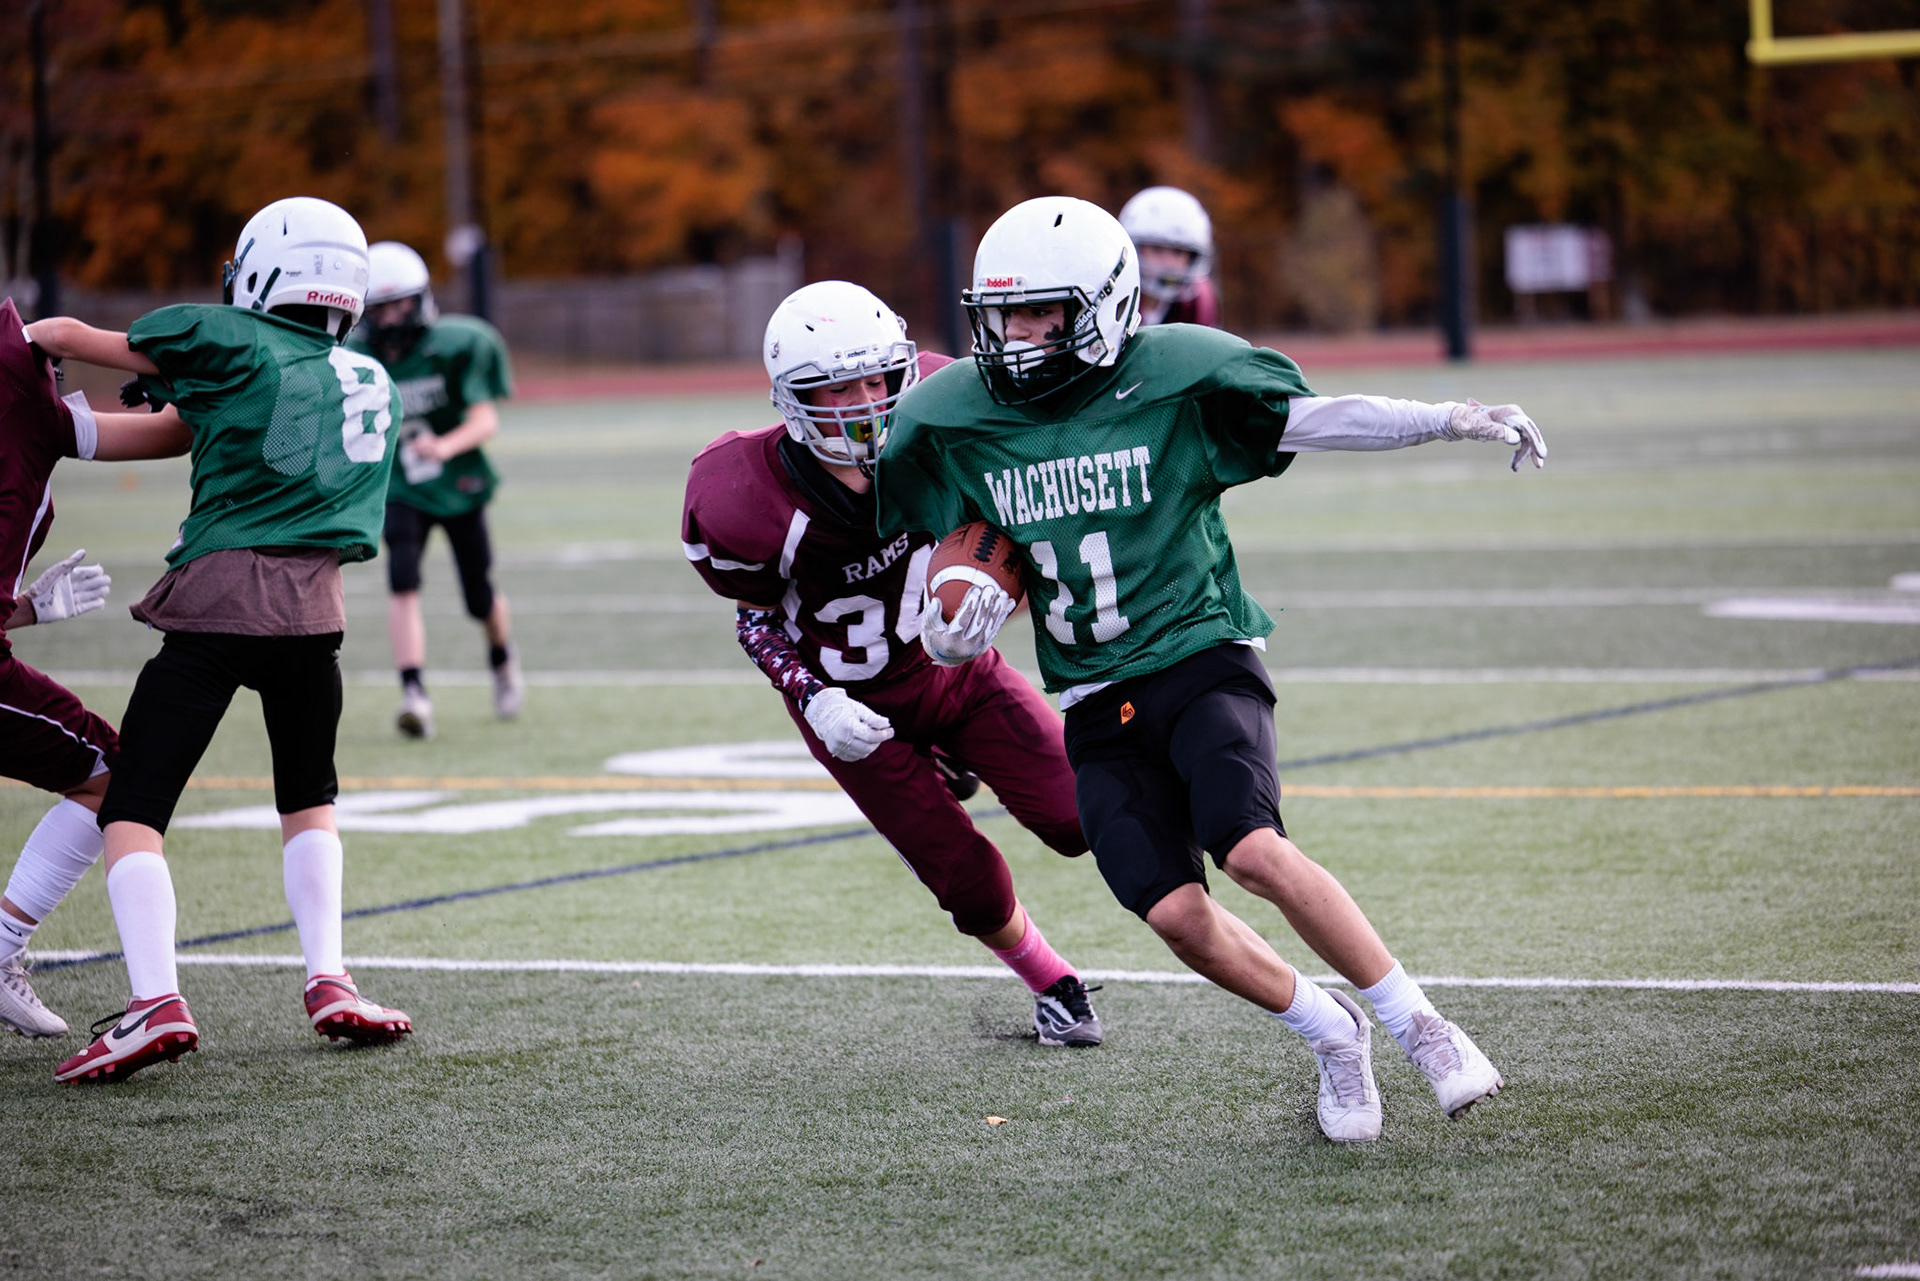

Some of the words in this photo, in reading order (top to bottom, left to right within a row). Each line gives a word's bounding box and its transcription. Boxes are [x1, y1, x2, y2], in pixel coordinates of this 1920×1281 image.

[306, 290, 359, 310] Riddell
[328, 345, 392, 463] 8
[984, 445, 1152, 527] WACHUSETT
[842, 532, 910, 584] RAMS
[1030, 530, 1131, 645] 11
